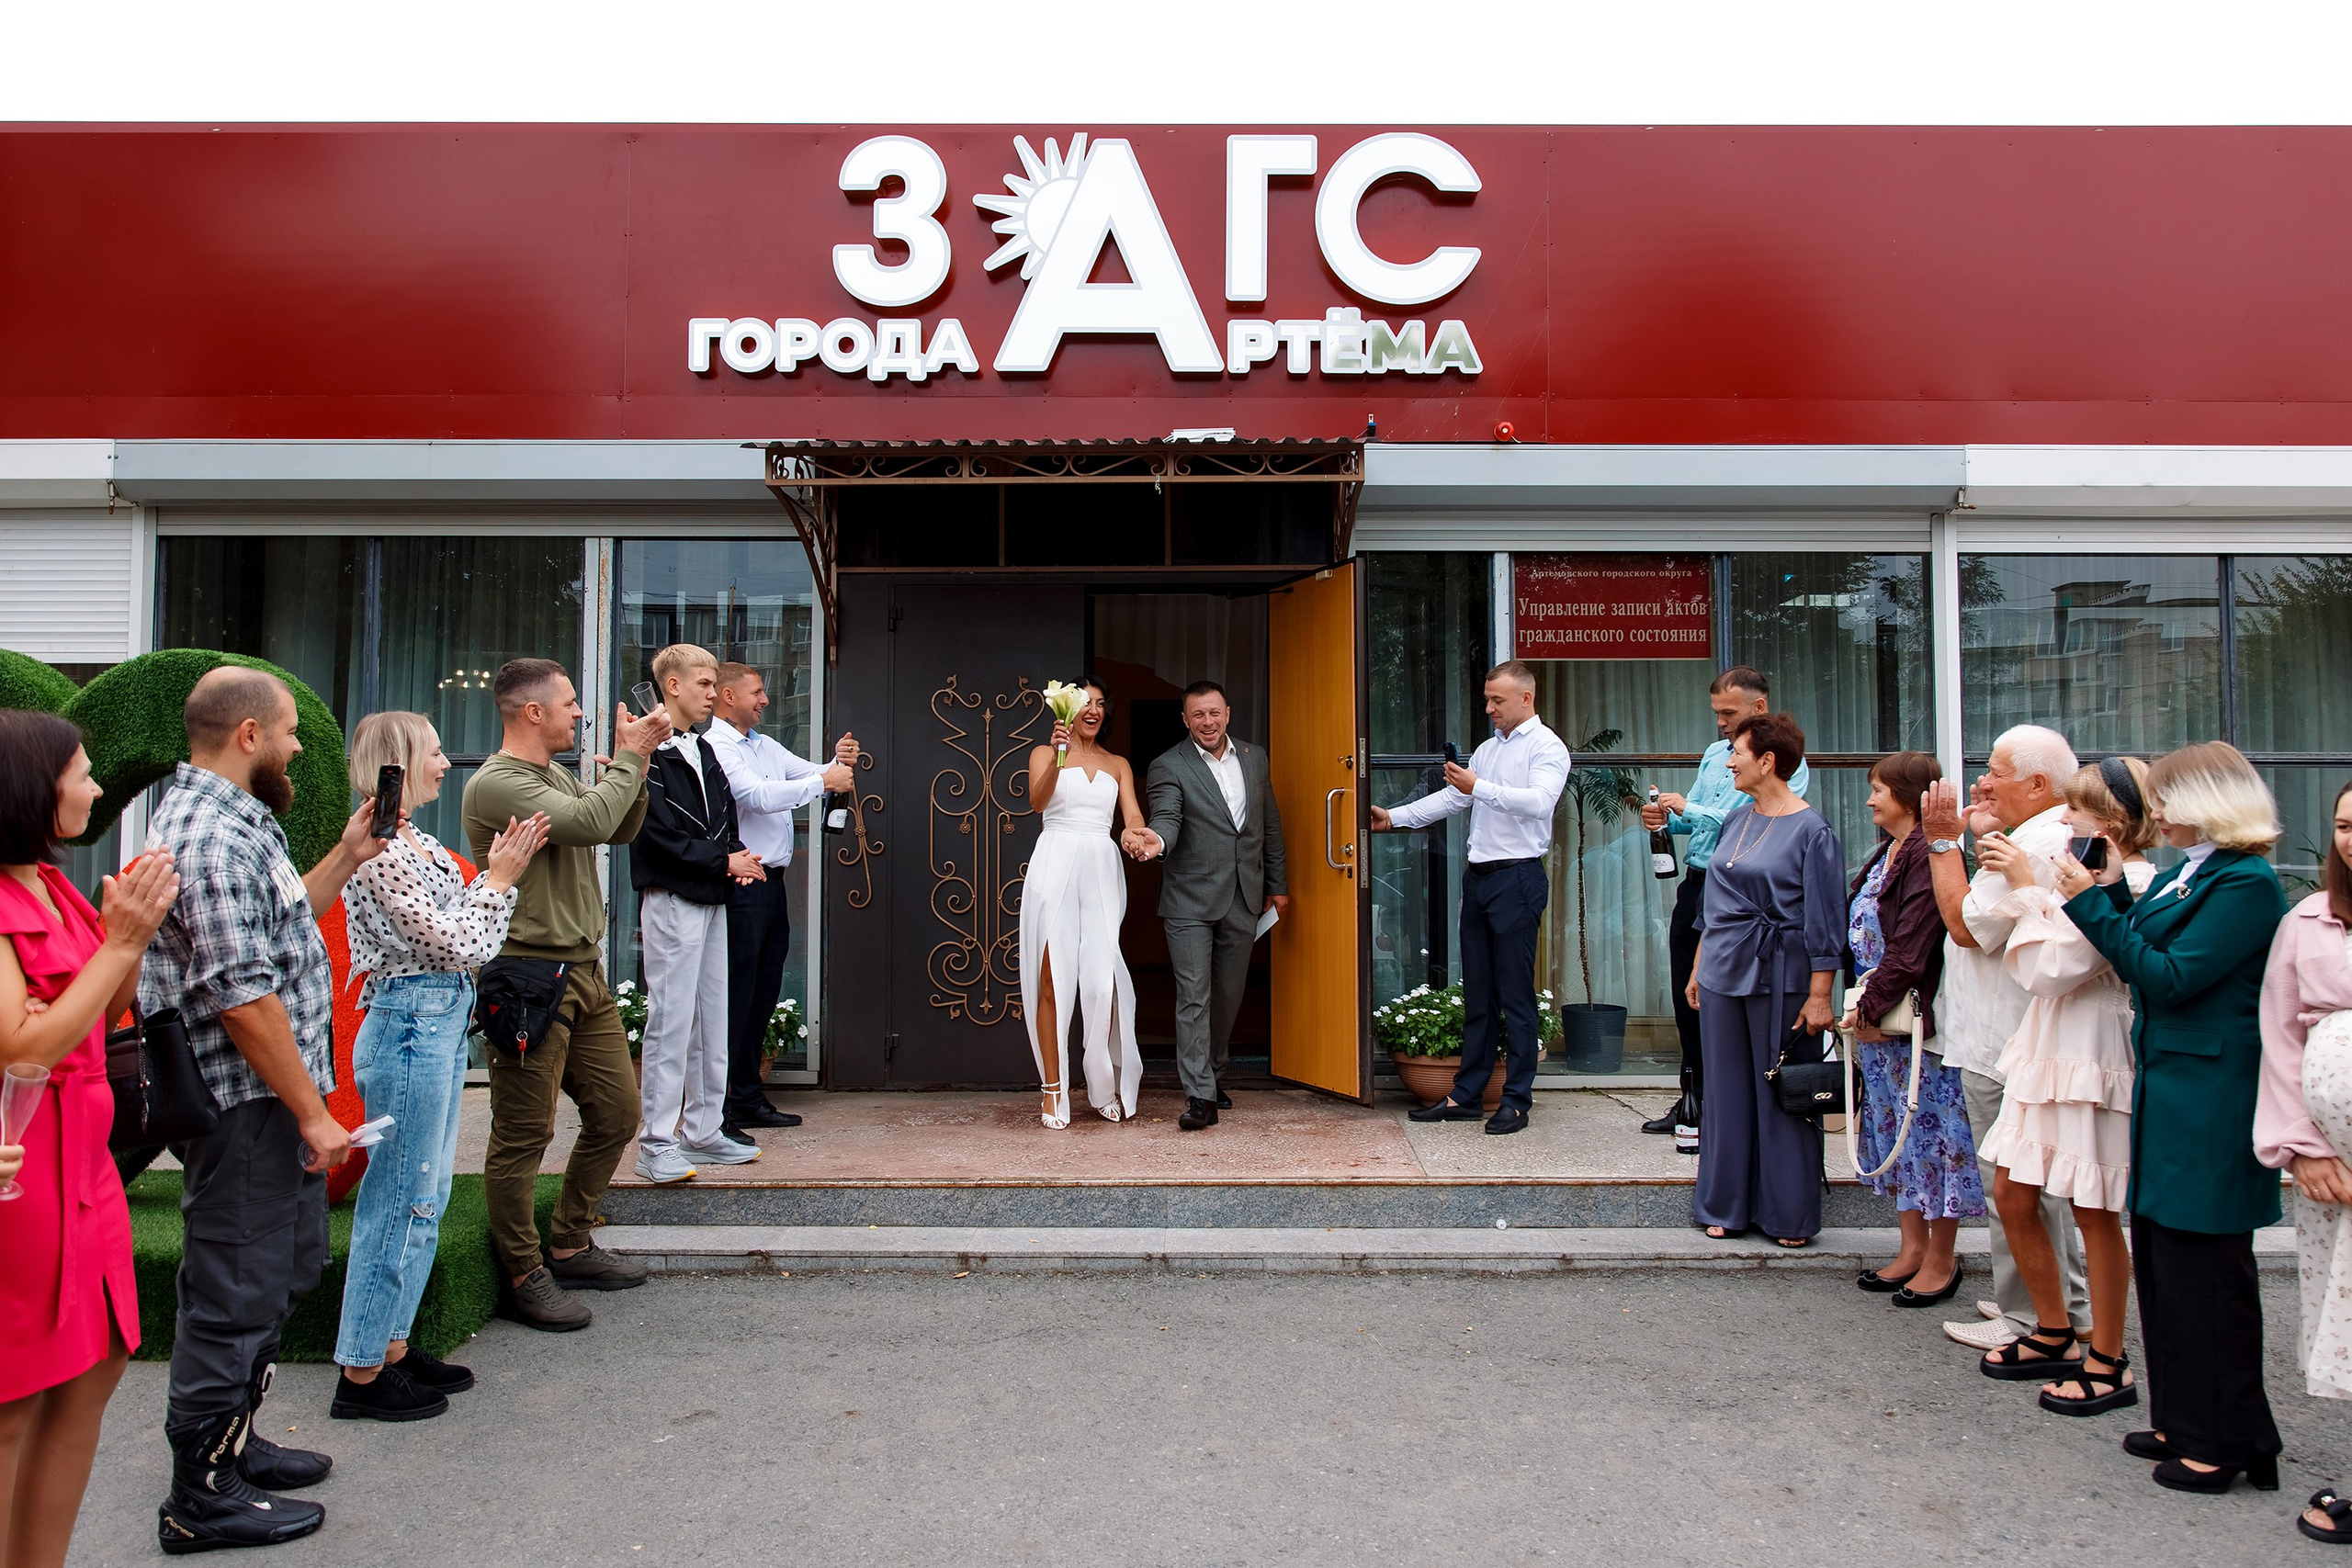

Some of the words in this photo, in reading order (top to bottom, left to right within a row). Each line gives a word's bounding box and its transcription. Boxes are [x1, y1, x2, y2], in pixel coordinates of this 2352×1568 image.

[832, 132, 1483, 373] ЗАГС
[687, 317, 979, 382] ГОРОДА
[1602, 570, 1657, 580] городского
[1659, 570, 1692, 579] округа
[1519, 597, 1606, 621] Управление
[1611, 603, 1661, 616] записи
[1666, 602, 1707, 616] актов
[1519, 628, 1624, 648] гражданского
[1629, 628, 1707, 642] состояния
